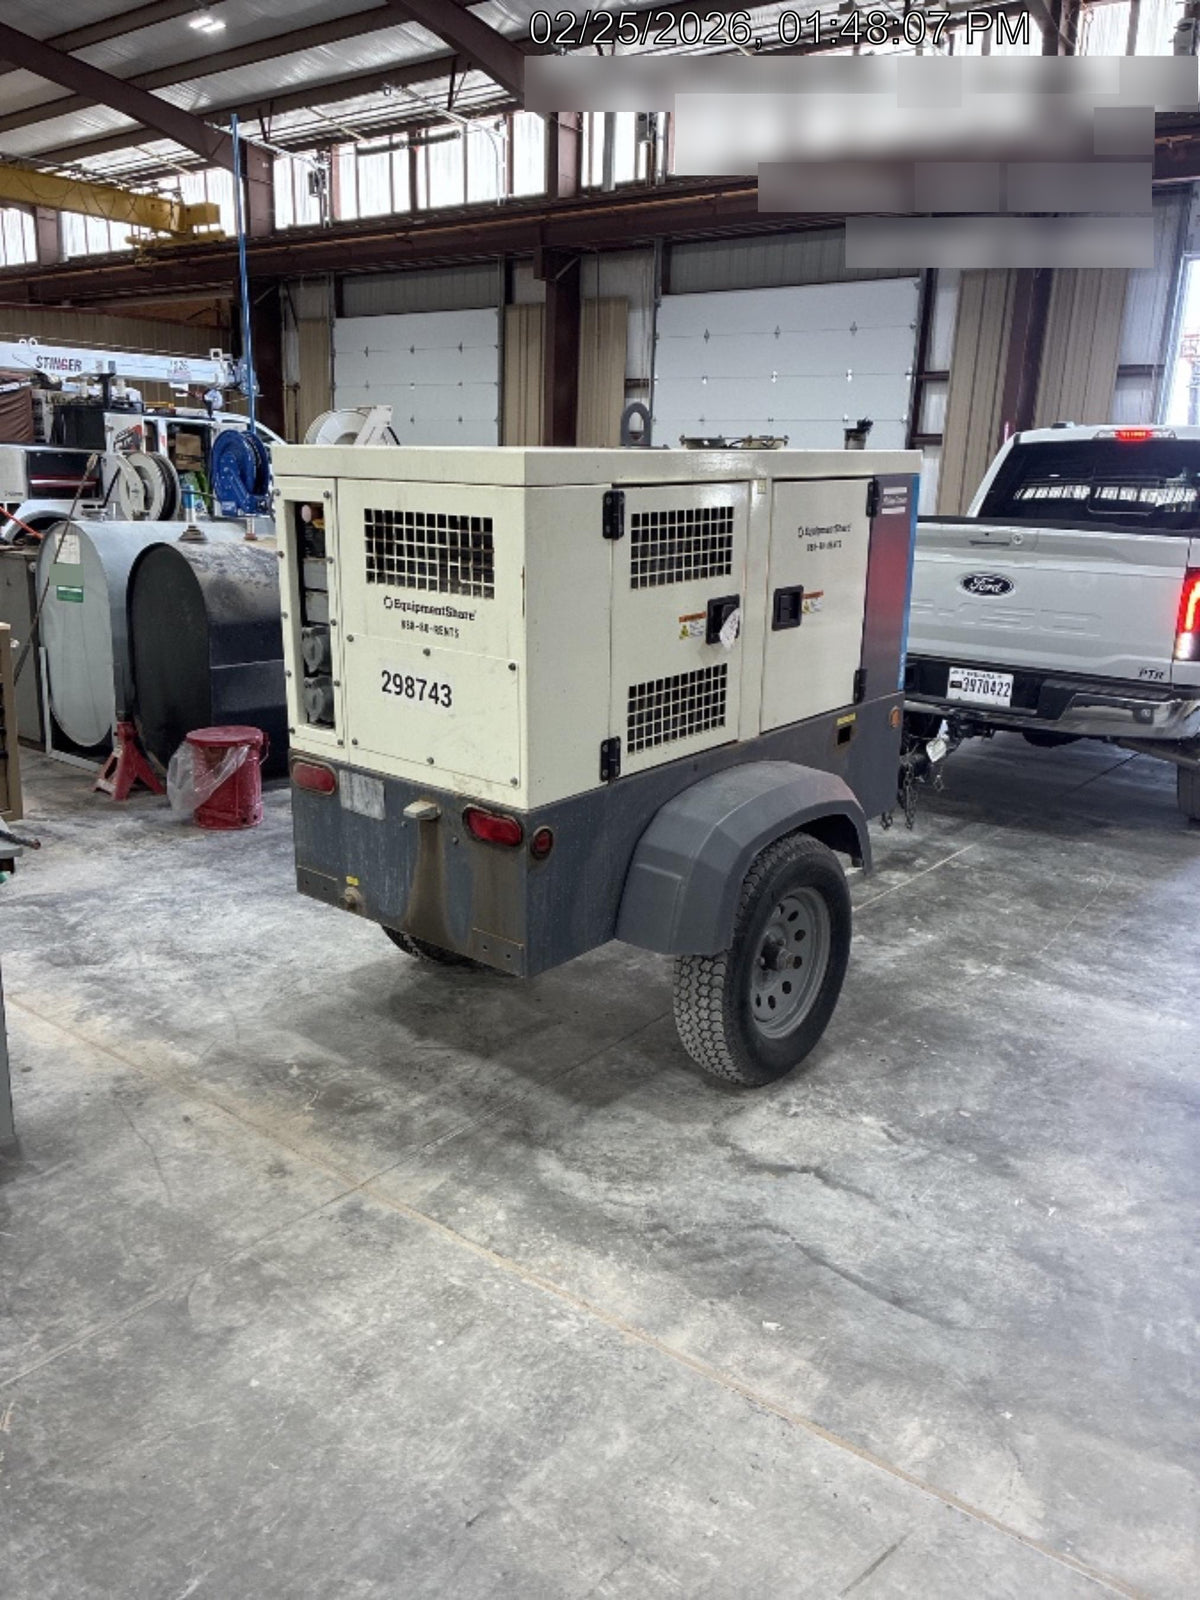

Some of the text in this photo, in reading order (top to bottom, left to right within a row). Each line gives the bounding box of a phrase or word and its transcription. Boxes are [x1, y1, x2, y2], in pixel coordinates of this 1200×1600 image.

[35, 355, 82, 372] STINGER
[394, 598, 476, 621] EquipmentShare
[381, 669, 452, 708] 298743
[962, 677, 1011, 698] 3970422
